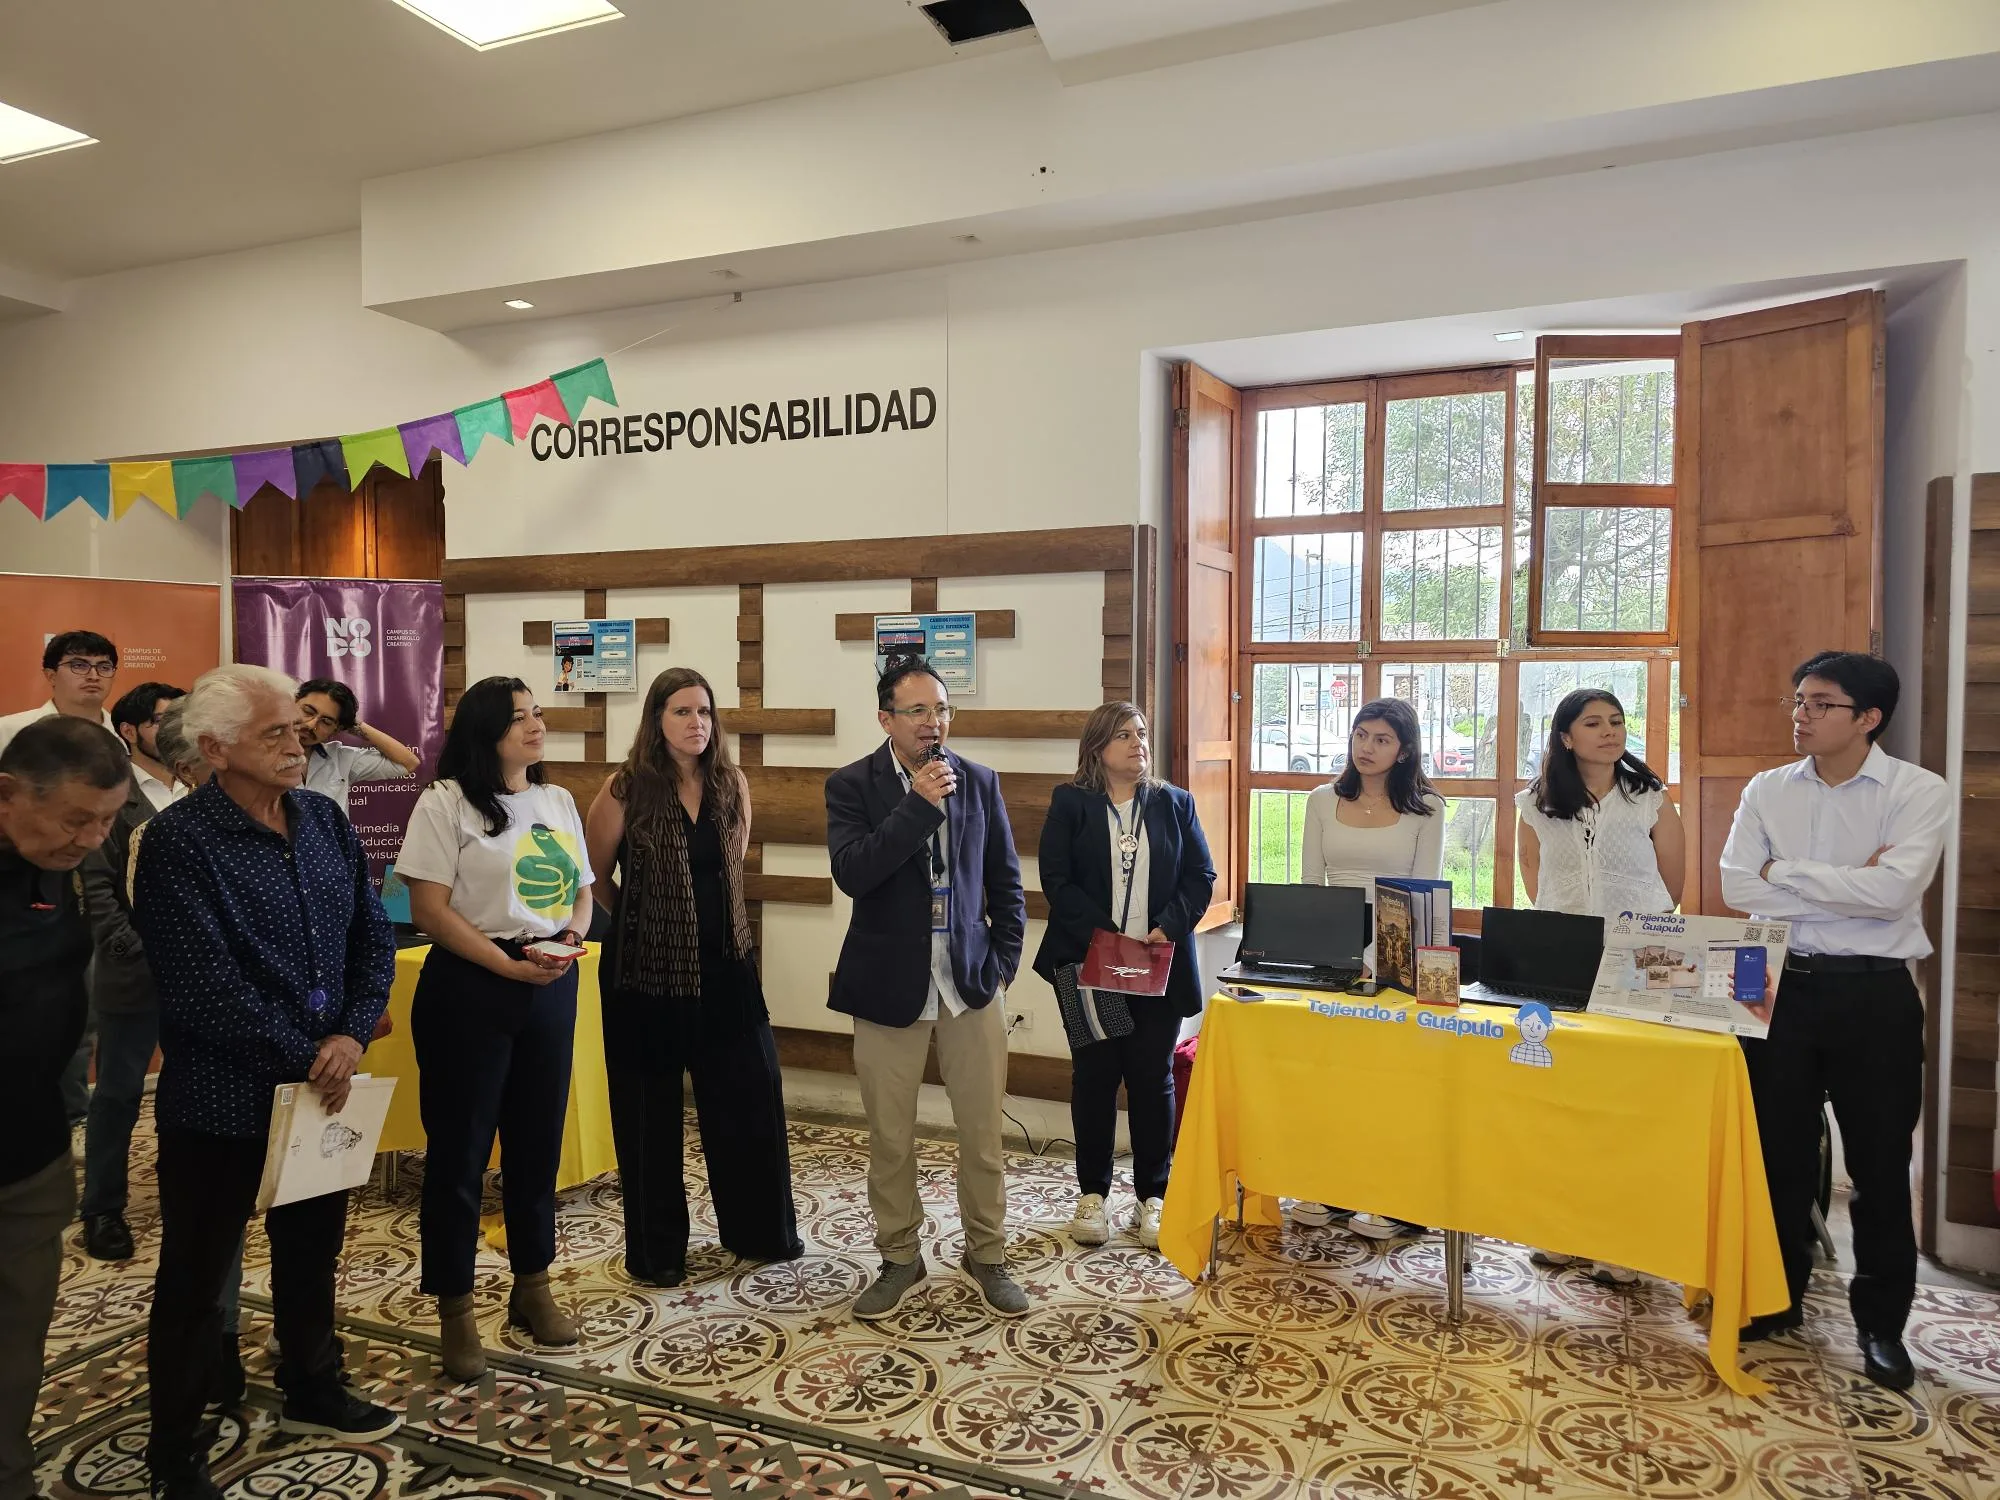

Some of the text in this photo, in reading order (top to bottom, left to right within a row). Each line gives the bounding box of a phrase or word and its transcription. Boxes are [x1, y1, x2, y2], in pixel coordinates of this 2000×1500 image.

[531, 386, 937, 462] CORRESPONSABILIDAD
[1635, 912, 1676, 924] Tejiendo
[1642, 922, 1685, 933] Guápulo
[1308, 999, 1504, 1039] Tejiendo a Guápulo
